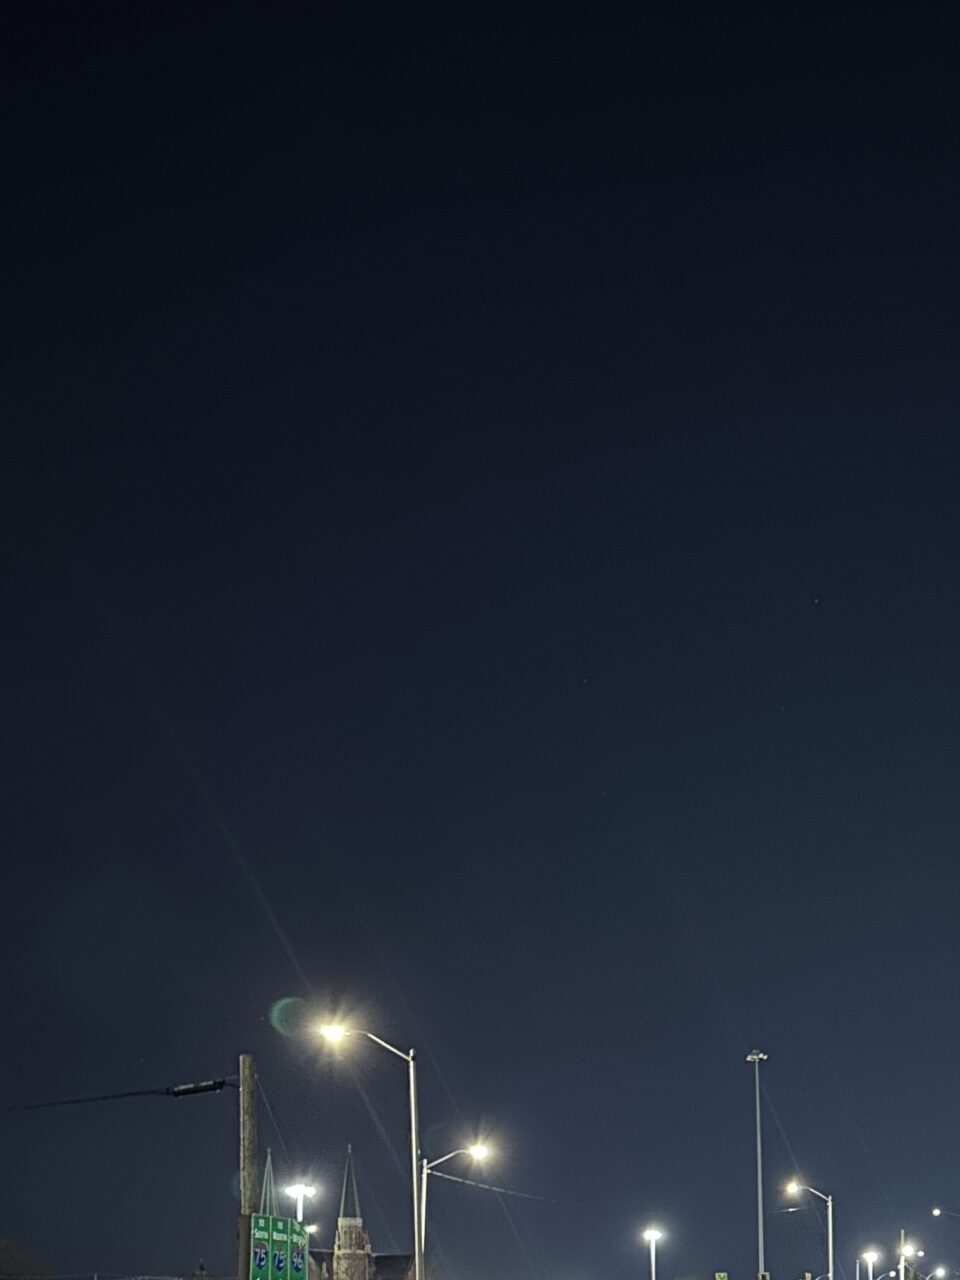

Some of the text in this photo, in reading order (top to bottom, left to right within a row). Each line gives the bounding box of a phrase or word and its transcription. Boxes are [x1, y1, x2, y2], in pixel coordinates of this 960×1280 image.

[255, 1249, 267, 1265] 75
[273, 1251, 285, 1267] 75
[293, 1252, 303, 1268] 96
